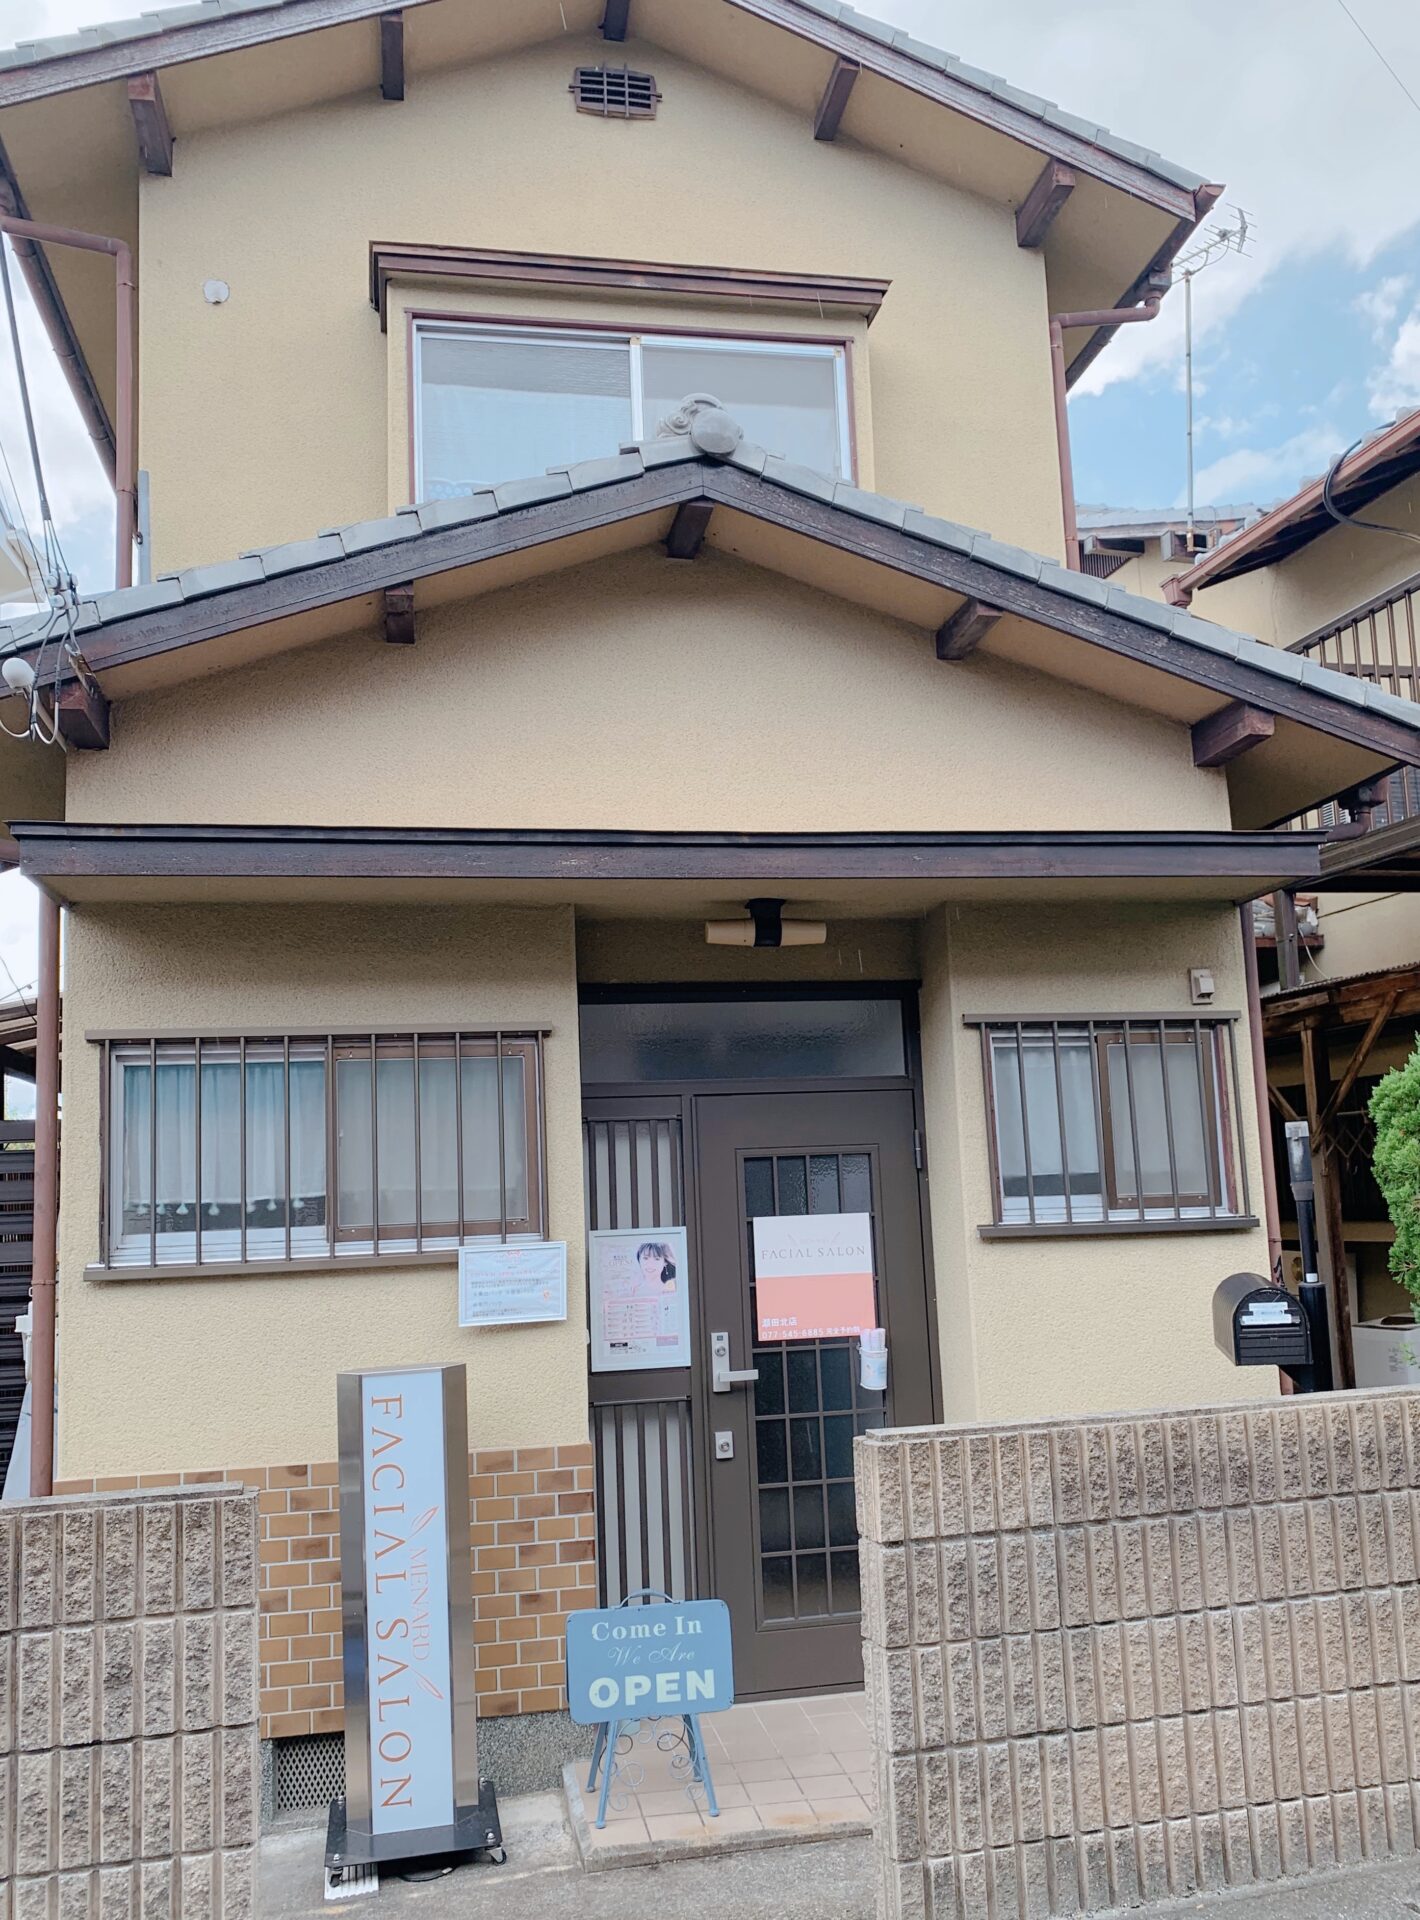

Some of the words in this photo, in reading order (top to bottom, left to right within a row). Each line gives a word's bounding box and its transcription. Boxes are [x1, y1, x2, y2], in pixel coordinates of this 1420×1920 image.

[761, 1248, 812, 1260] FACIAL
[818, 1245, 865, 1257] SALON
[371, 1393, 408, 1594] FACIAL
[408, 1548, 431, 1662] MENARD
[591, 1621, 667, 1642] Come
[674, 1615, 703, 1636] In
[607, 1644, 643, 1667] We
[648, 1641, 696, 1664] Are
[588, 1668, 716, 1709] OPEN
[375, 1617, 413, 1808] SALON
